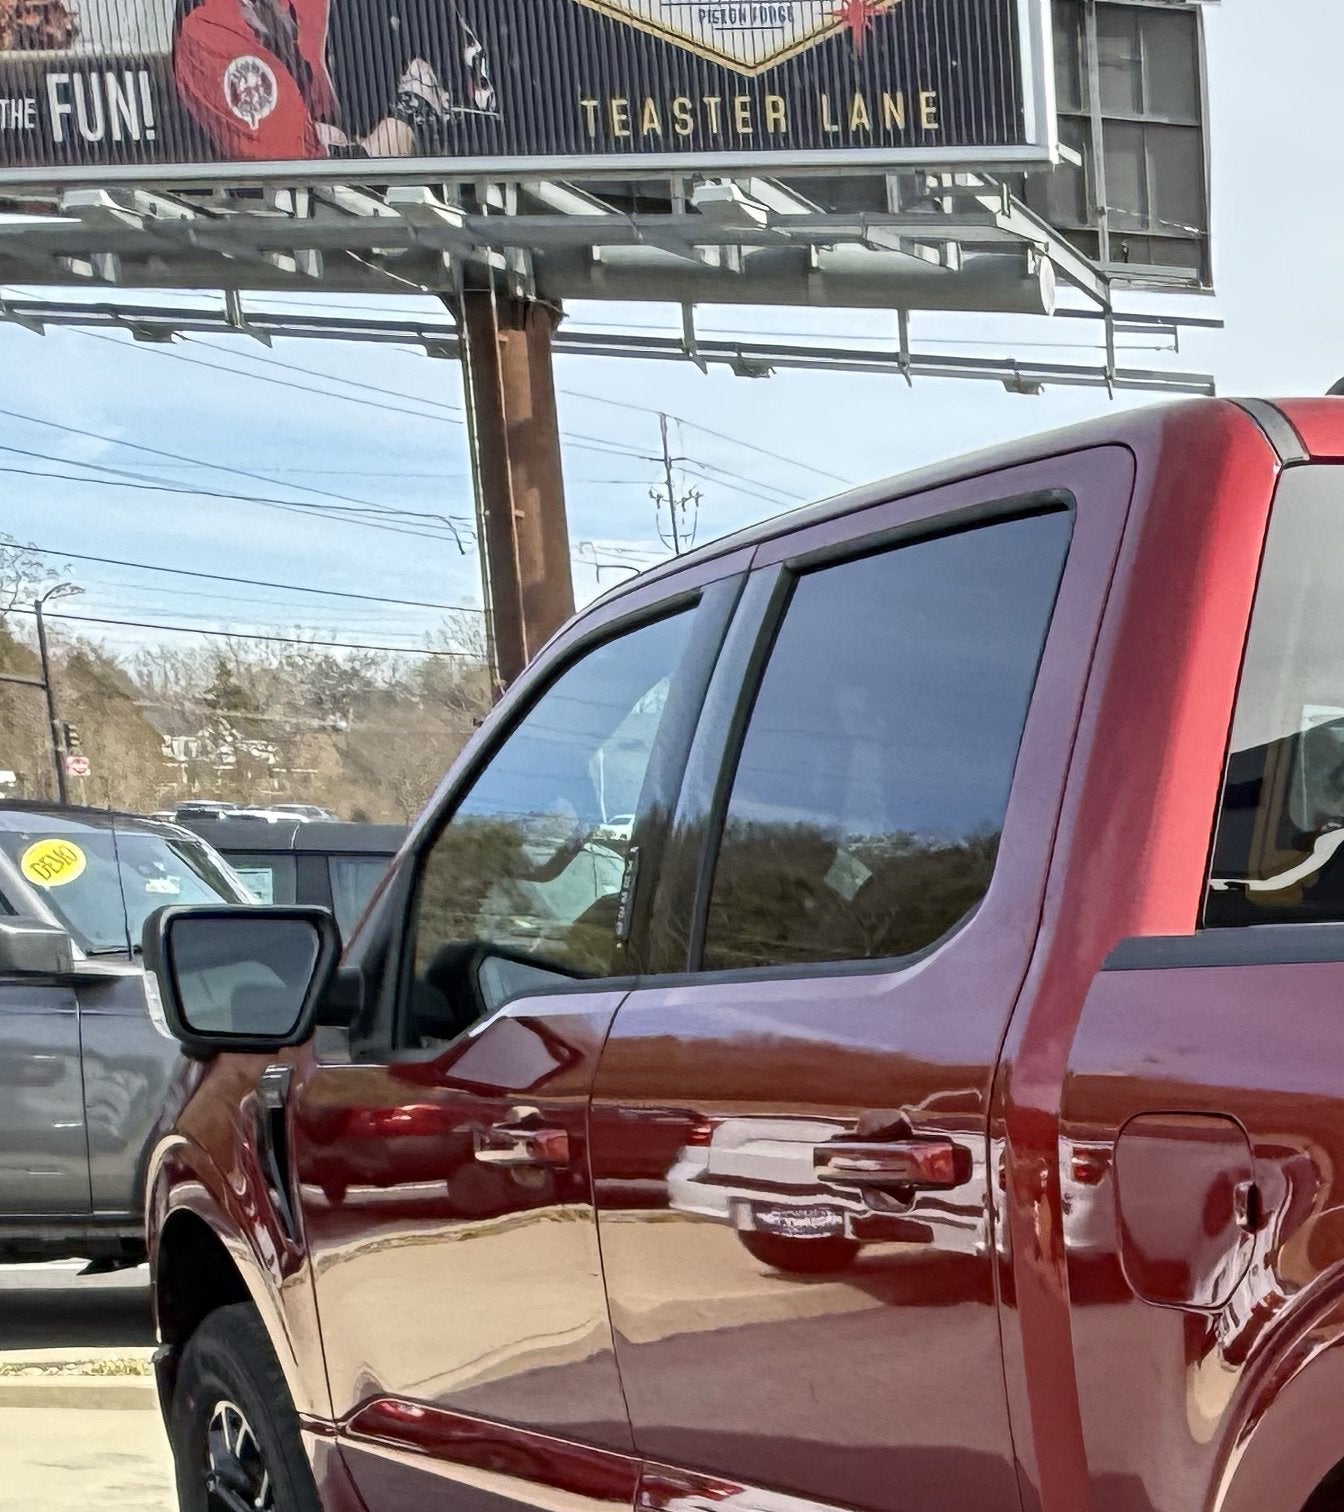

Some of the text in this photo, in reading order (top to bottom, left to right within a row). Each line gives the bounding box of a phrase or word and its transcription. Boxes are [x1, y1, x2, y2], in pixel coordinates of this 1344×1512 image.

[0, 70, 155, 142] THE FUN!
[579, 91, 940, 137] TEASTER LANE
